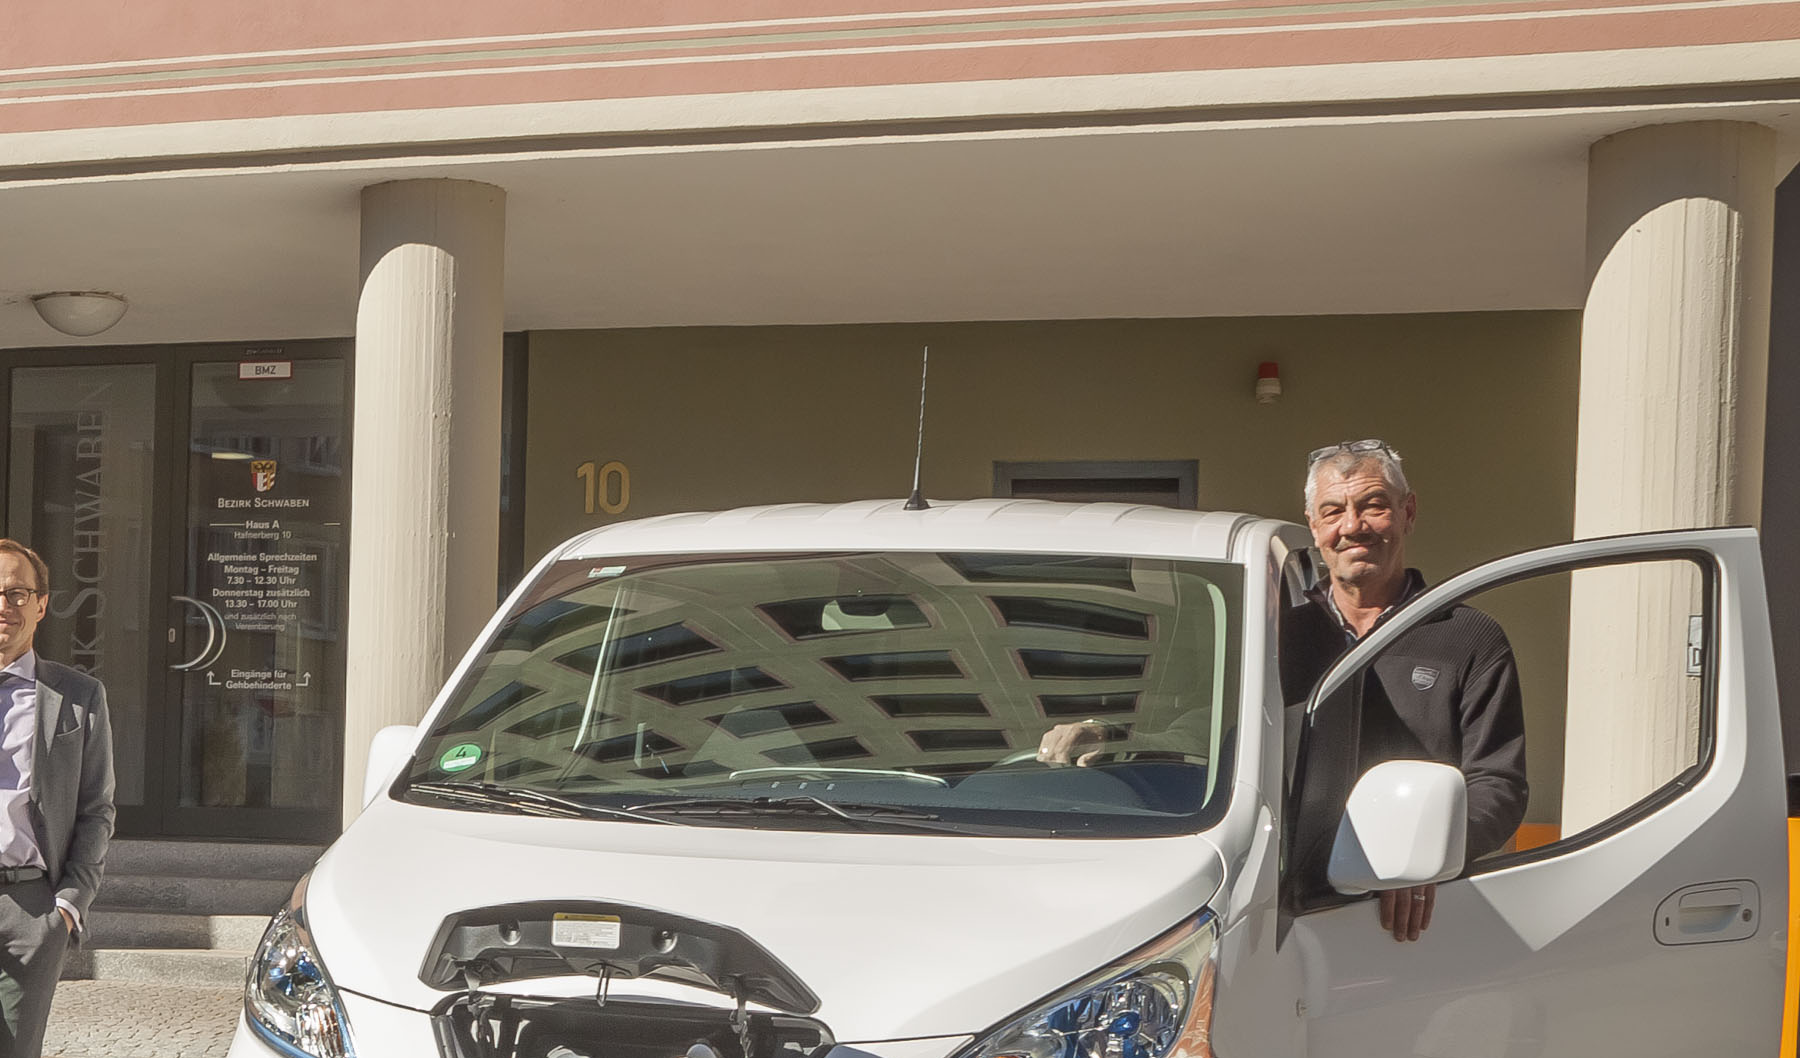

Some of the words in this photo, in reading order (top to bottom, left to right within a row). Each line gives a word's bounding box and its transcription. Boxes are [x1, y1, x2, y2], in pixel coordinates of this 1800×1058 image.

[255, 365, 277, 375] BMZ
[576, 461, 630, 514] 10
[245, 520, 270, 529] Haus
[272, 520, 280, 529] A
[234, 531, 279, 540] Hafnerberg
[281, 531, 292, 539] 10
[207, 553, 257, 564] Allgemeine
[259, 552, 318, 563] Sprechzeiten
[224, 565, 259, 575] Montag
[268, 565, 300, 575] Freitag
[227, 576, 245, 585] 7.30
[254, 576, 278, 585] 12.30
[279, 576, 296, 585] Uhr
[212, 588, 264, 599] Donnerstag
[265, 588, 310, 598] zusätzlich
[225, 600, 248, 608] 13.30
[257, 600, 279, 608] 17.00
[281, 599, 298, 608] Uhr
[224, 612, 239, 620] und
[231, 669, 272, 680] Eingänge
[273, 670, 287, 679] für
[225, 681, 292, 690] Gehbehinderte
[455, 746, 466, 758] 4
